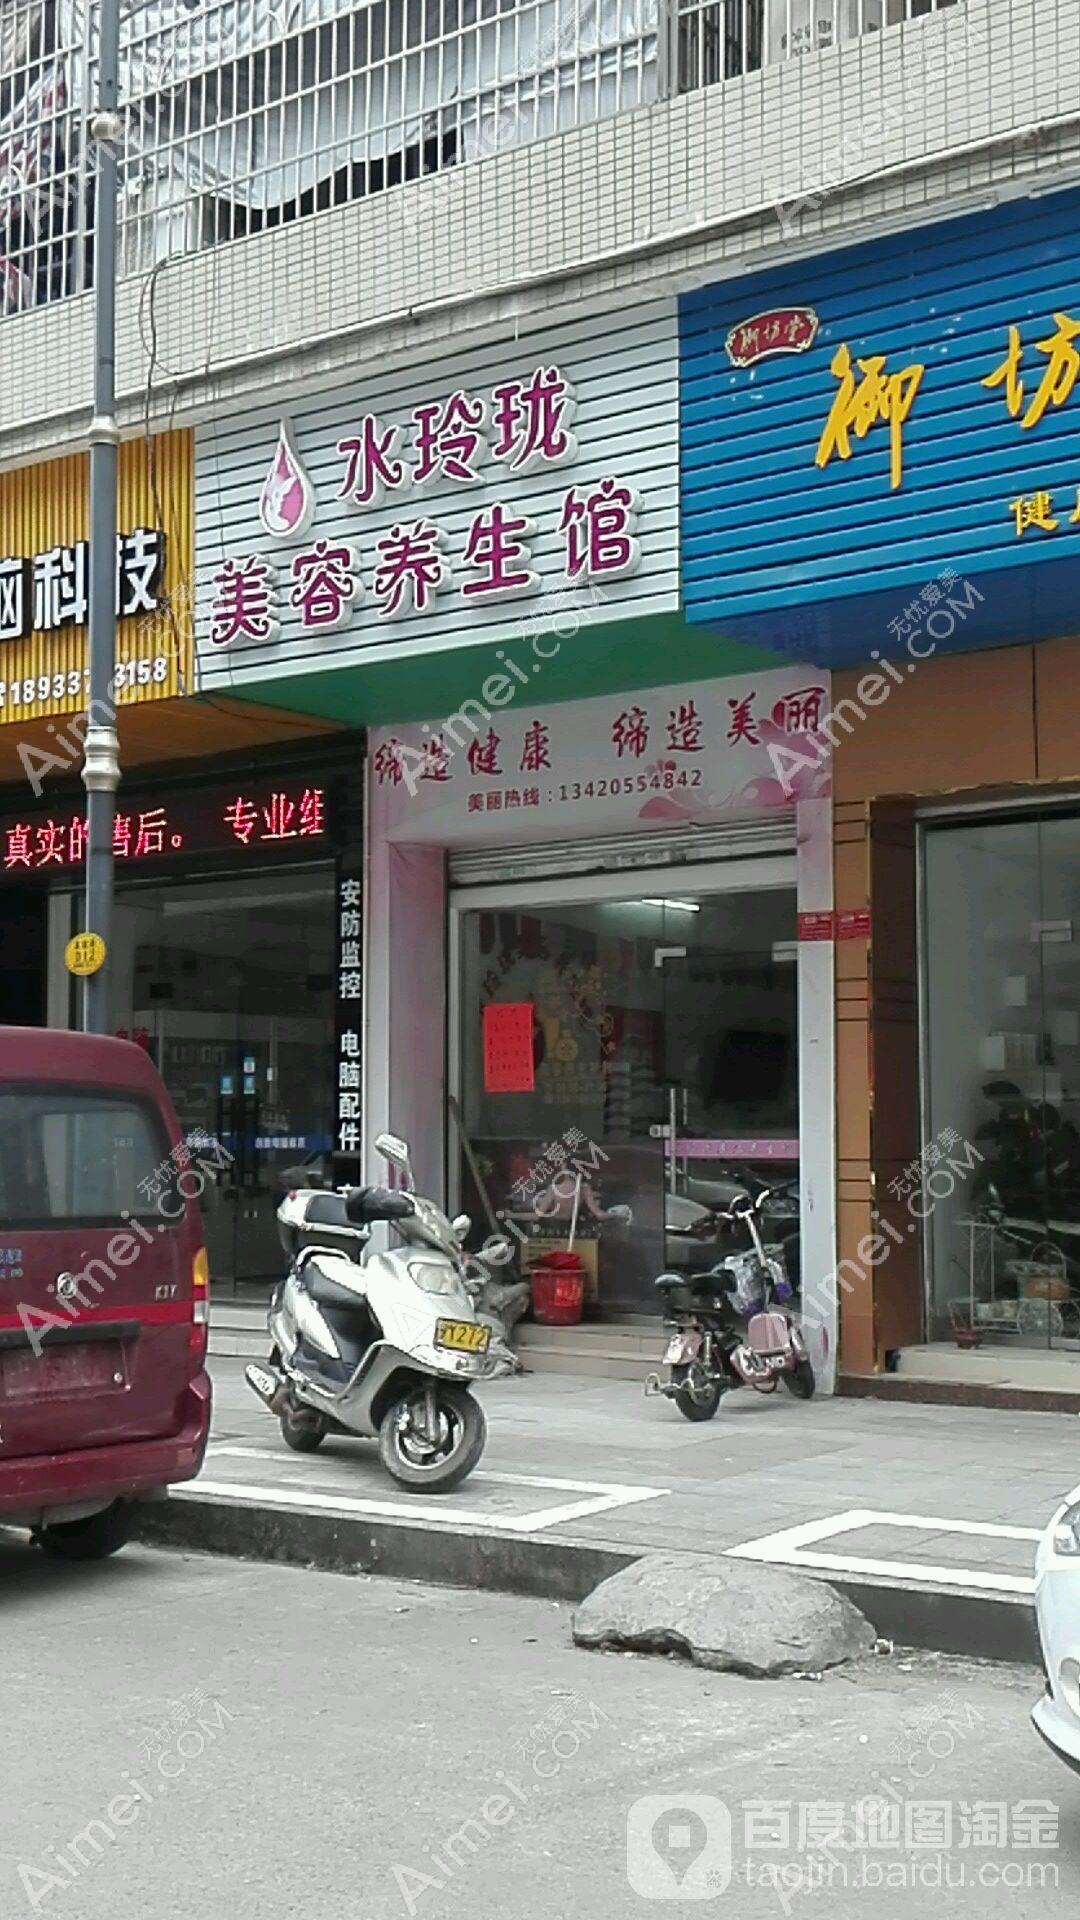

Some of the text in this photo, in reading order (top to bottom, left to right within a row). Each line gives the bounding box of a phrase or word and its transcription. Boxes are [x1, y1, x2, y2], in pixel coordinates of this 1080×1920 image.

[336, 365, 570, 506] 水玲珑
[210, 477, 634, 646] 美容养生馆
[1008, 485, 1080, 537] 健
[611, 686, 827, 760] 缔造美丽
[338, 878, 362, 1152] 安防监控 电脑配件
